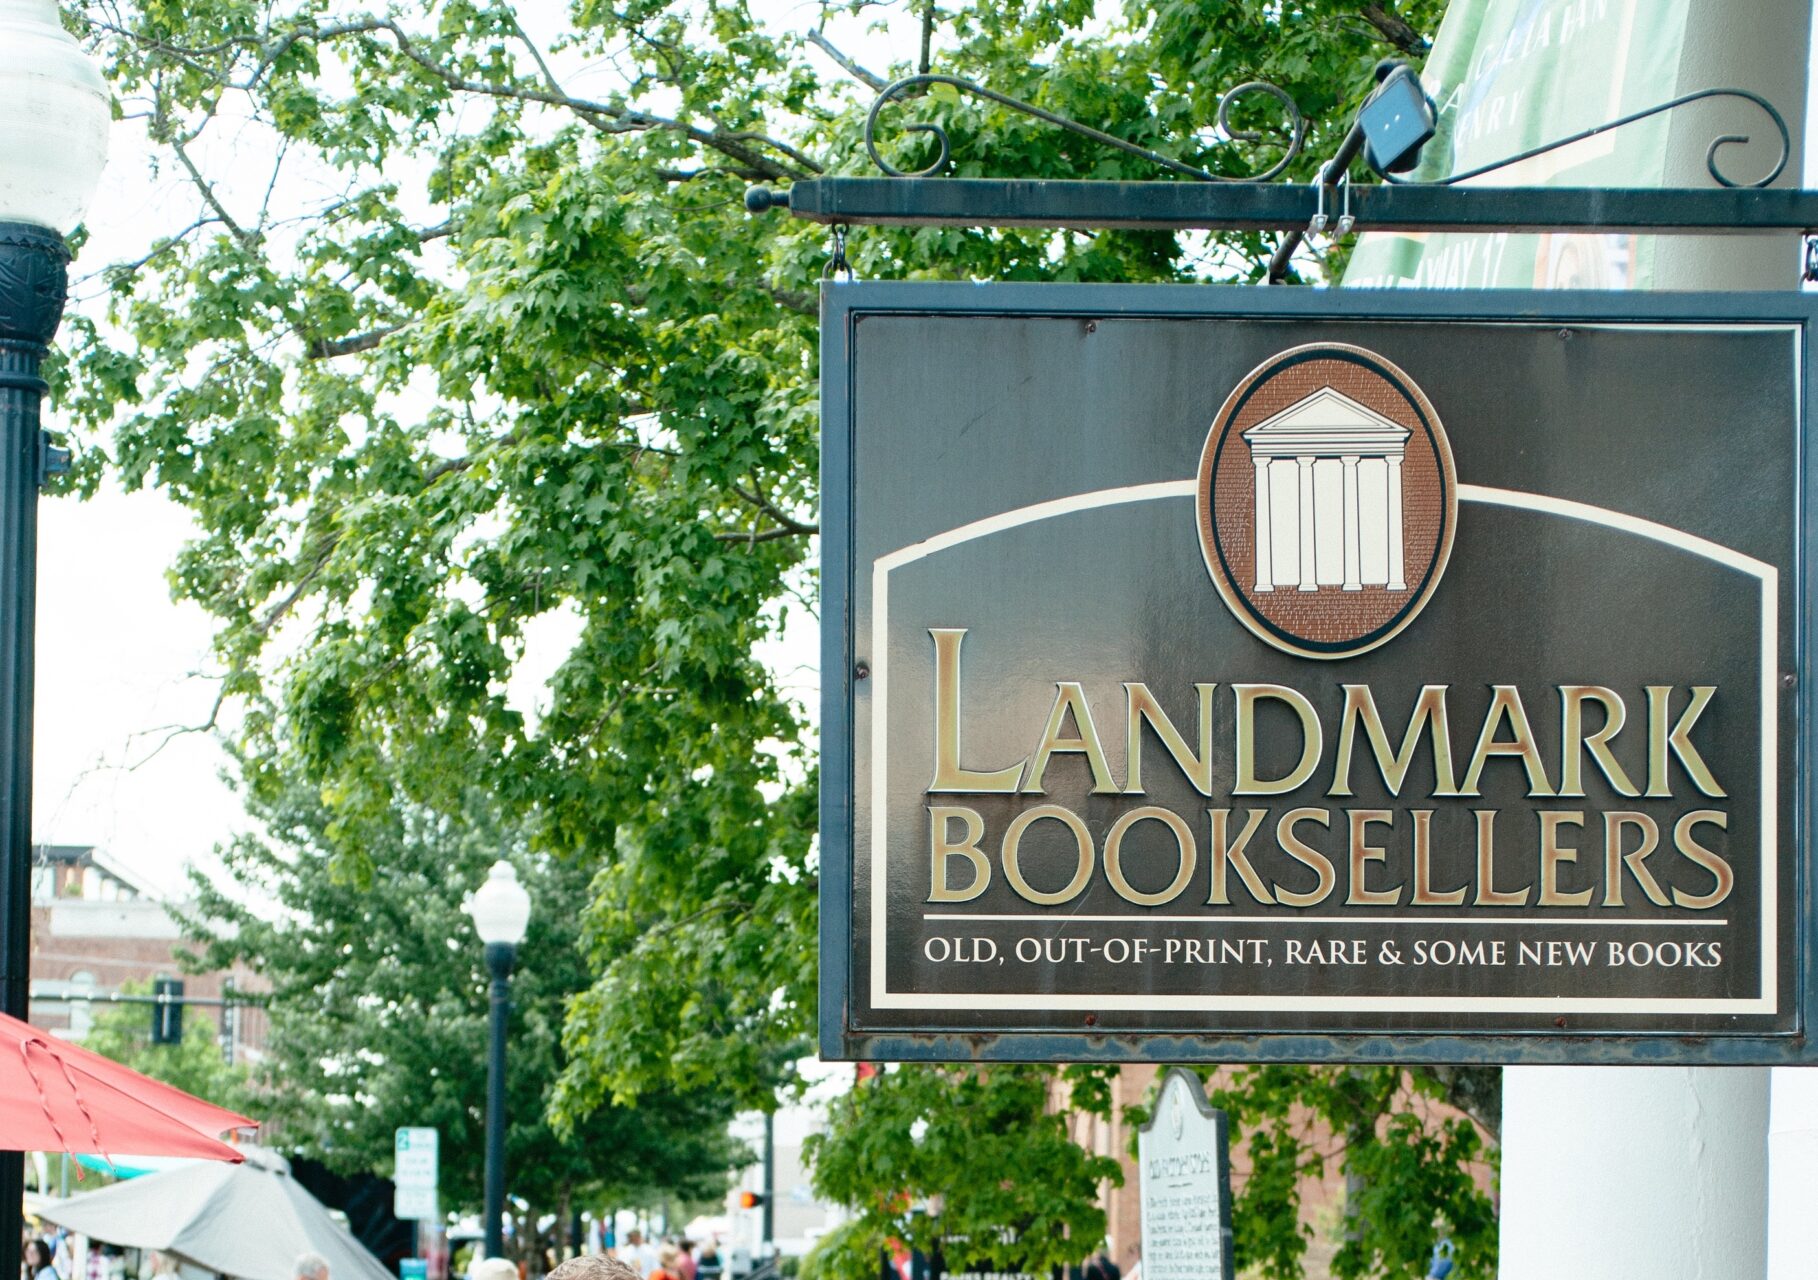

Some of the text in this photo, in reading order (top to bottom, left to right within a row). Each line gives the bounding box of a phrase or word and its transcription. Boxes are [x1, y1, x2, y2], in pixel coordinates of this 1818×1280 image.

[1455, 86, 1526, 150] ENRY
[1481, 232, 1508, 289] 17
[927, 628, 1728, 798] LANDMARK
[926, 805, 1734, 910] BOOKSELLERS
[923, 937, 1722, 968] OLD, OUT-OF-PRINT, RARE & SOME NEW BOOKS
